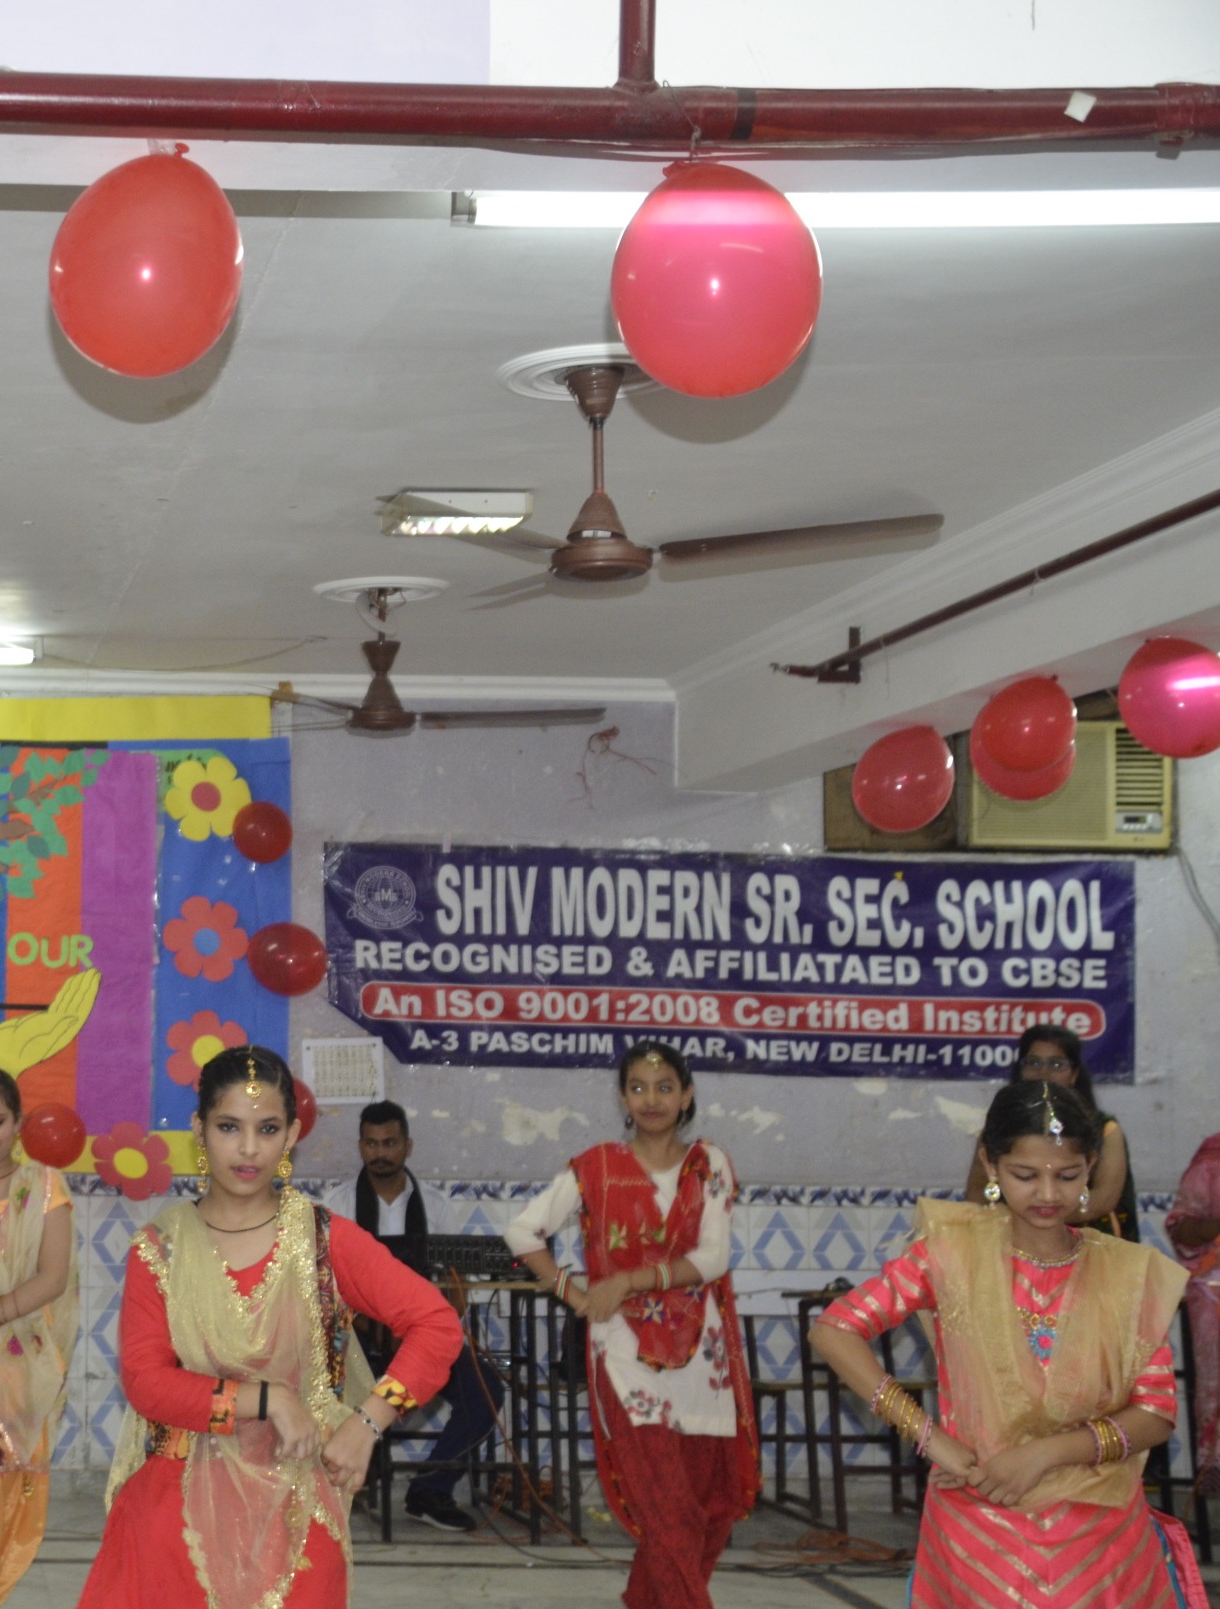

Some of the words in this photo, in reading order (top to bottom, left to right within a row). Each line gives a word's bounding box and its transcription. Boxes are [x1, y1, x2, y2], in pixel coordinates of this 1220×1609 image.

[435, 864, 537, 936] SHIV
[551, 866, 731, 941] MODERN
[745, 872, 813, 945] SR.
[827, 875, 924, 949] SEC.
[936, 878, 1114, 951] SCHOOL
[7, 932, 94, 968] OUR
[355, 939, 613, 975] RECOGNISED
[627, 945, 655, 976] &
[666, 948, 921, 987] AFFILIATAED
[933, 957, 988, 987] TO
[1001, 957, 1107, 989] CBSE
[373, 988, 422, 1016] An
[436, 990, 504, 1019] ISO
[518, 991, 720, 1024] 9001:2008
[733, 998, 909, 1031] Certified
[410, 1029, 459, 1050] A-3
[470, 1031, 614, 1054] PASCHIM
[746, 1039, 819, 1062] NEW
[828, 1042, 1020, 1067] DELHI-1100
